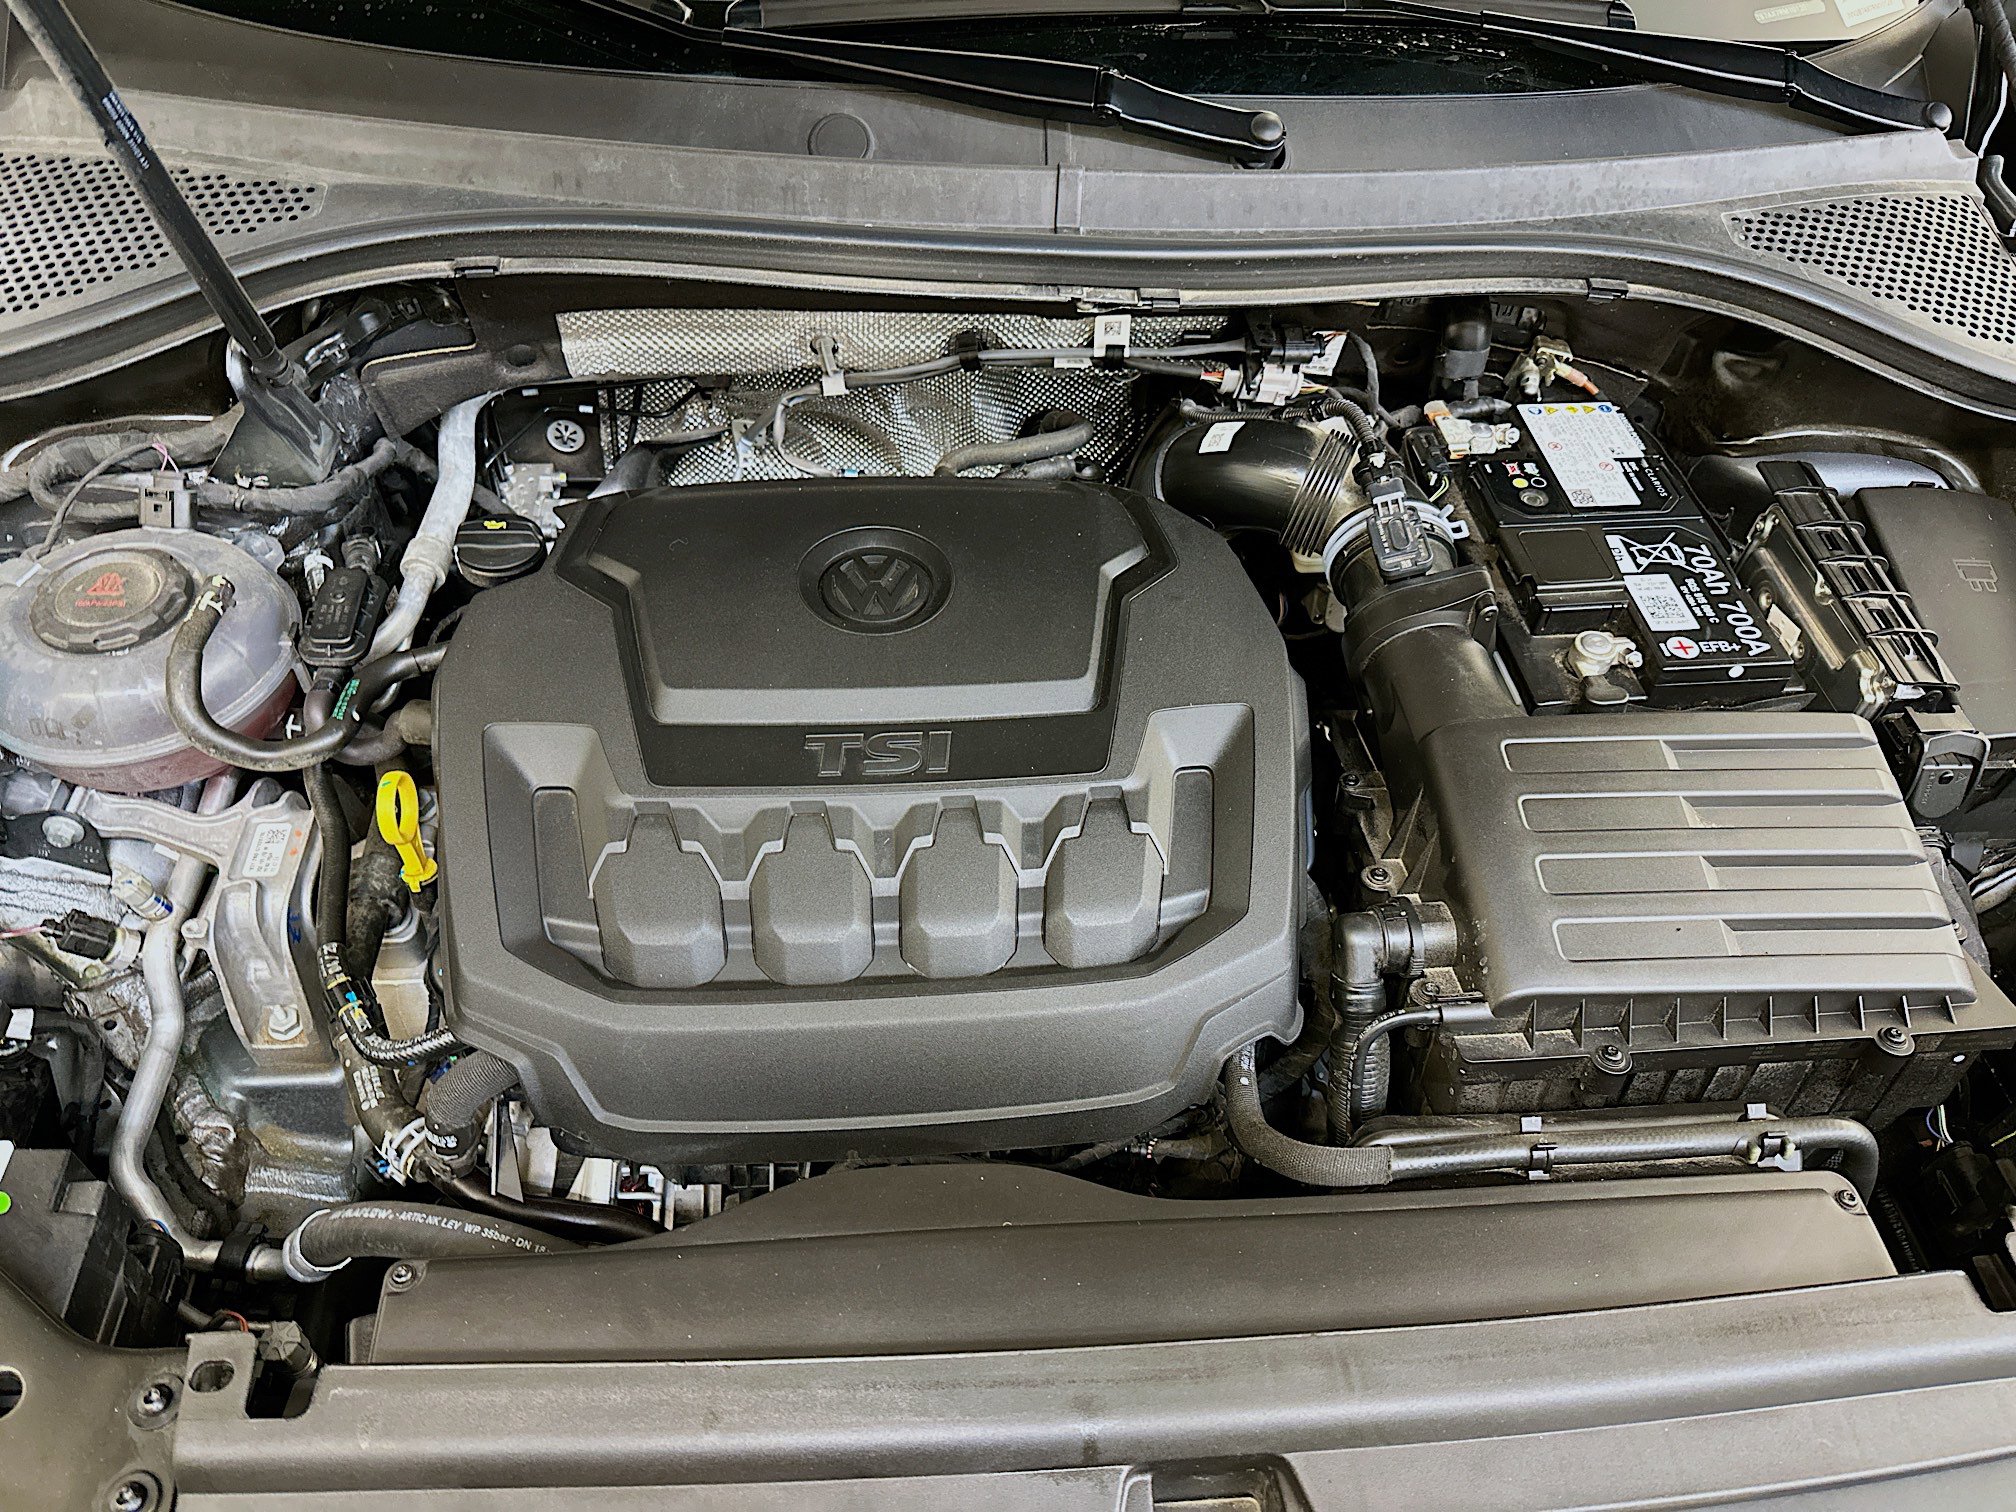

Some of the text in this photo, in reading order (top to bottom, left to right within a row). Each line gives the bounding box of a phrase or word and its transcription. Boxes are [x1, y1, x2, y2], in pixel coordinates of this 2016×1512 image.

[1645, 468, 1668, 497] CLARIOS
[1683, 544, 1731, 595] 70Ah
[1718, 600, 1771, 656] 700A
[1698, 640, 1741, 653] EFB+
[804, 731, 952, 776] TSI
[441, 1217, 462, 1231] LEV
[464, 1222, 482, 1235] WP
[515, 1236, 532, 1250] DN
